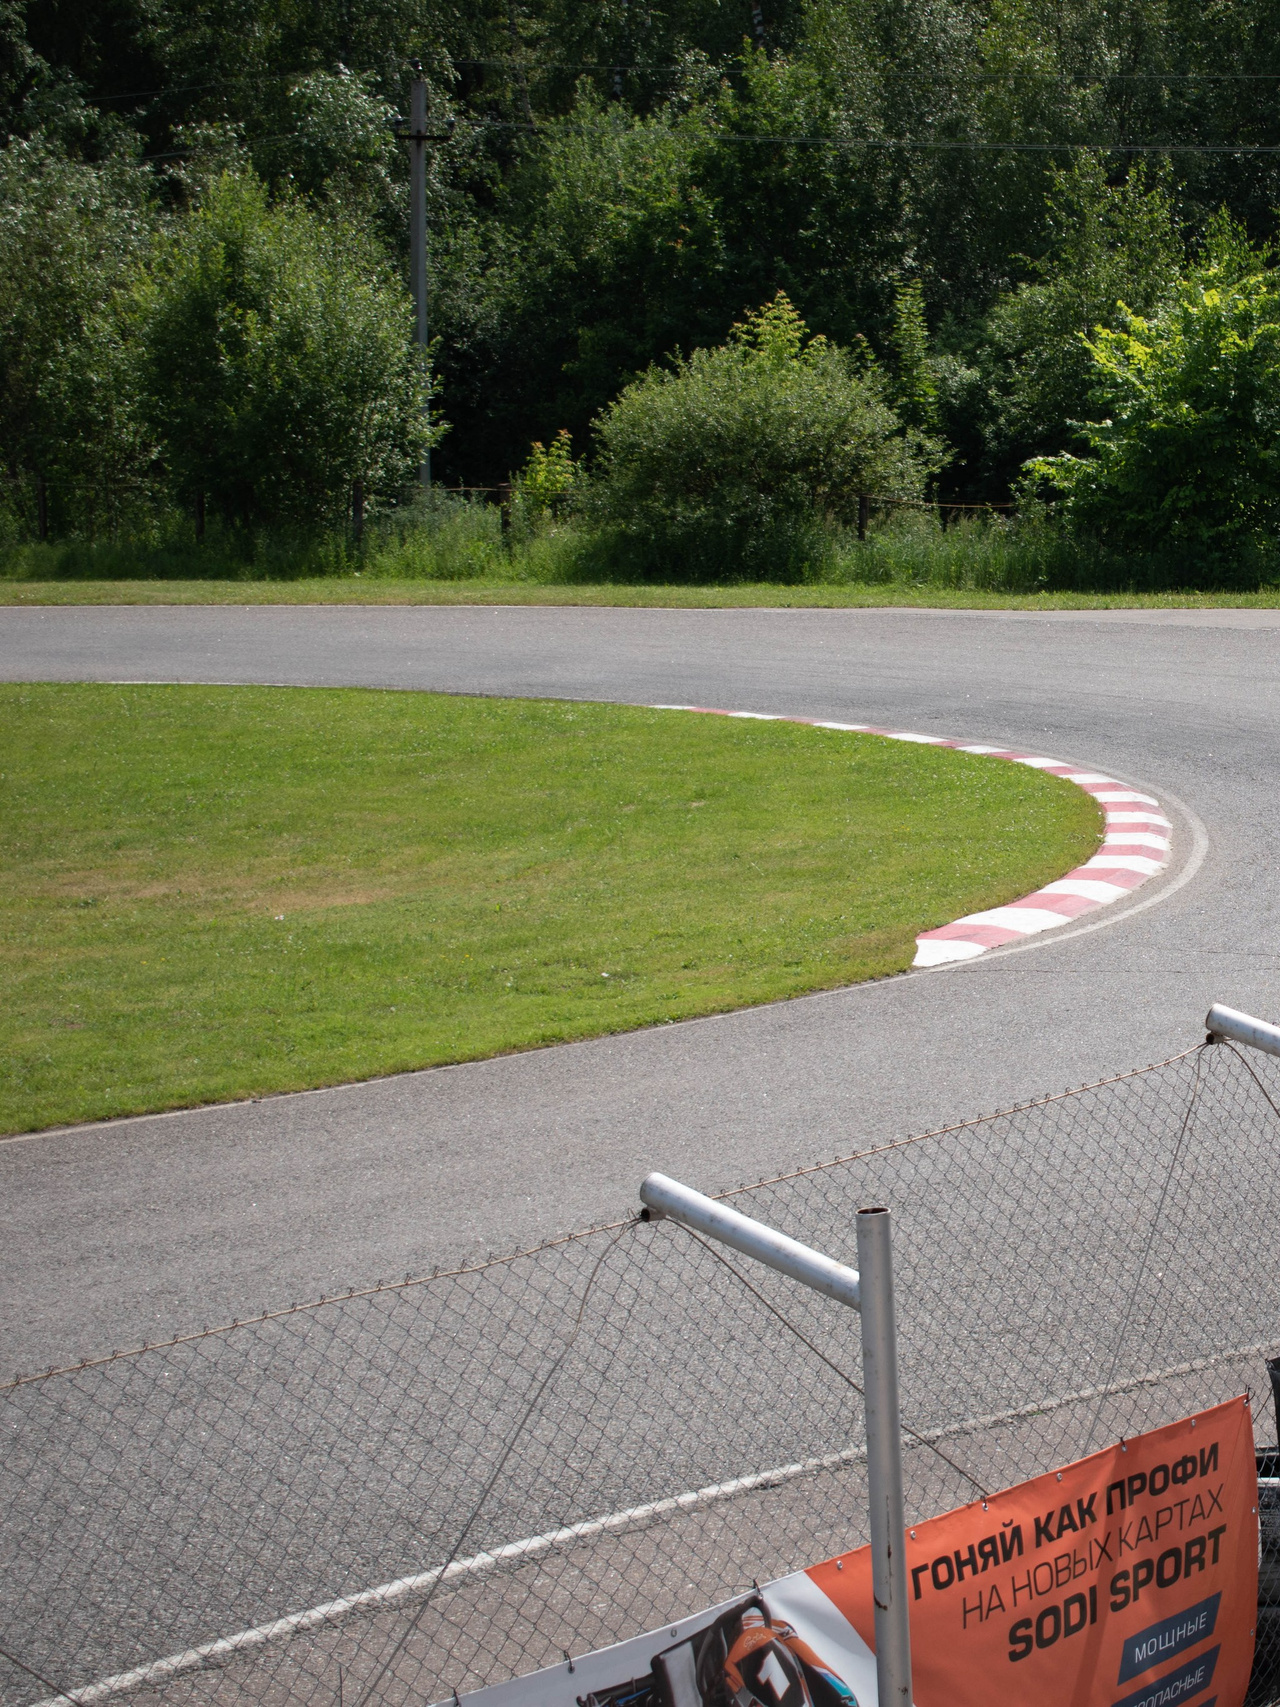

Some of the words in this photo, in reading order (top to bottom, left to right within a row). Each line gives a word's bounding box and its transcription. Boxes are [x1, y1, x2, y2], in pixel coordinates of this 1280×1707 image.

[910, 1518, 1025, 1601] ГОНЯЙ
[1034, 1491, 1098, 1549] КАК
[1105, 1441, 1220, 1516] ПРОФИ
[962, 1583, 1006, 1629] НА
[1012, 1530, 1114, 1608] НОВЫХ
[1118, 1482, 1225, 1557] КАРТАХ
[1007, 1585, 1098, 1663] SODI
[1109, 1523, 1228, 1613] SPORT
[1134, 1611, 1208, 1664] МОЩНЫЕ
[757, 1649, 791, 1701] 1
